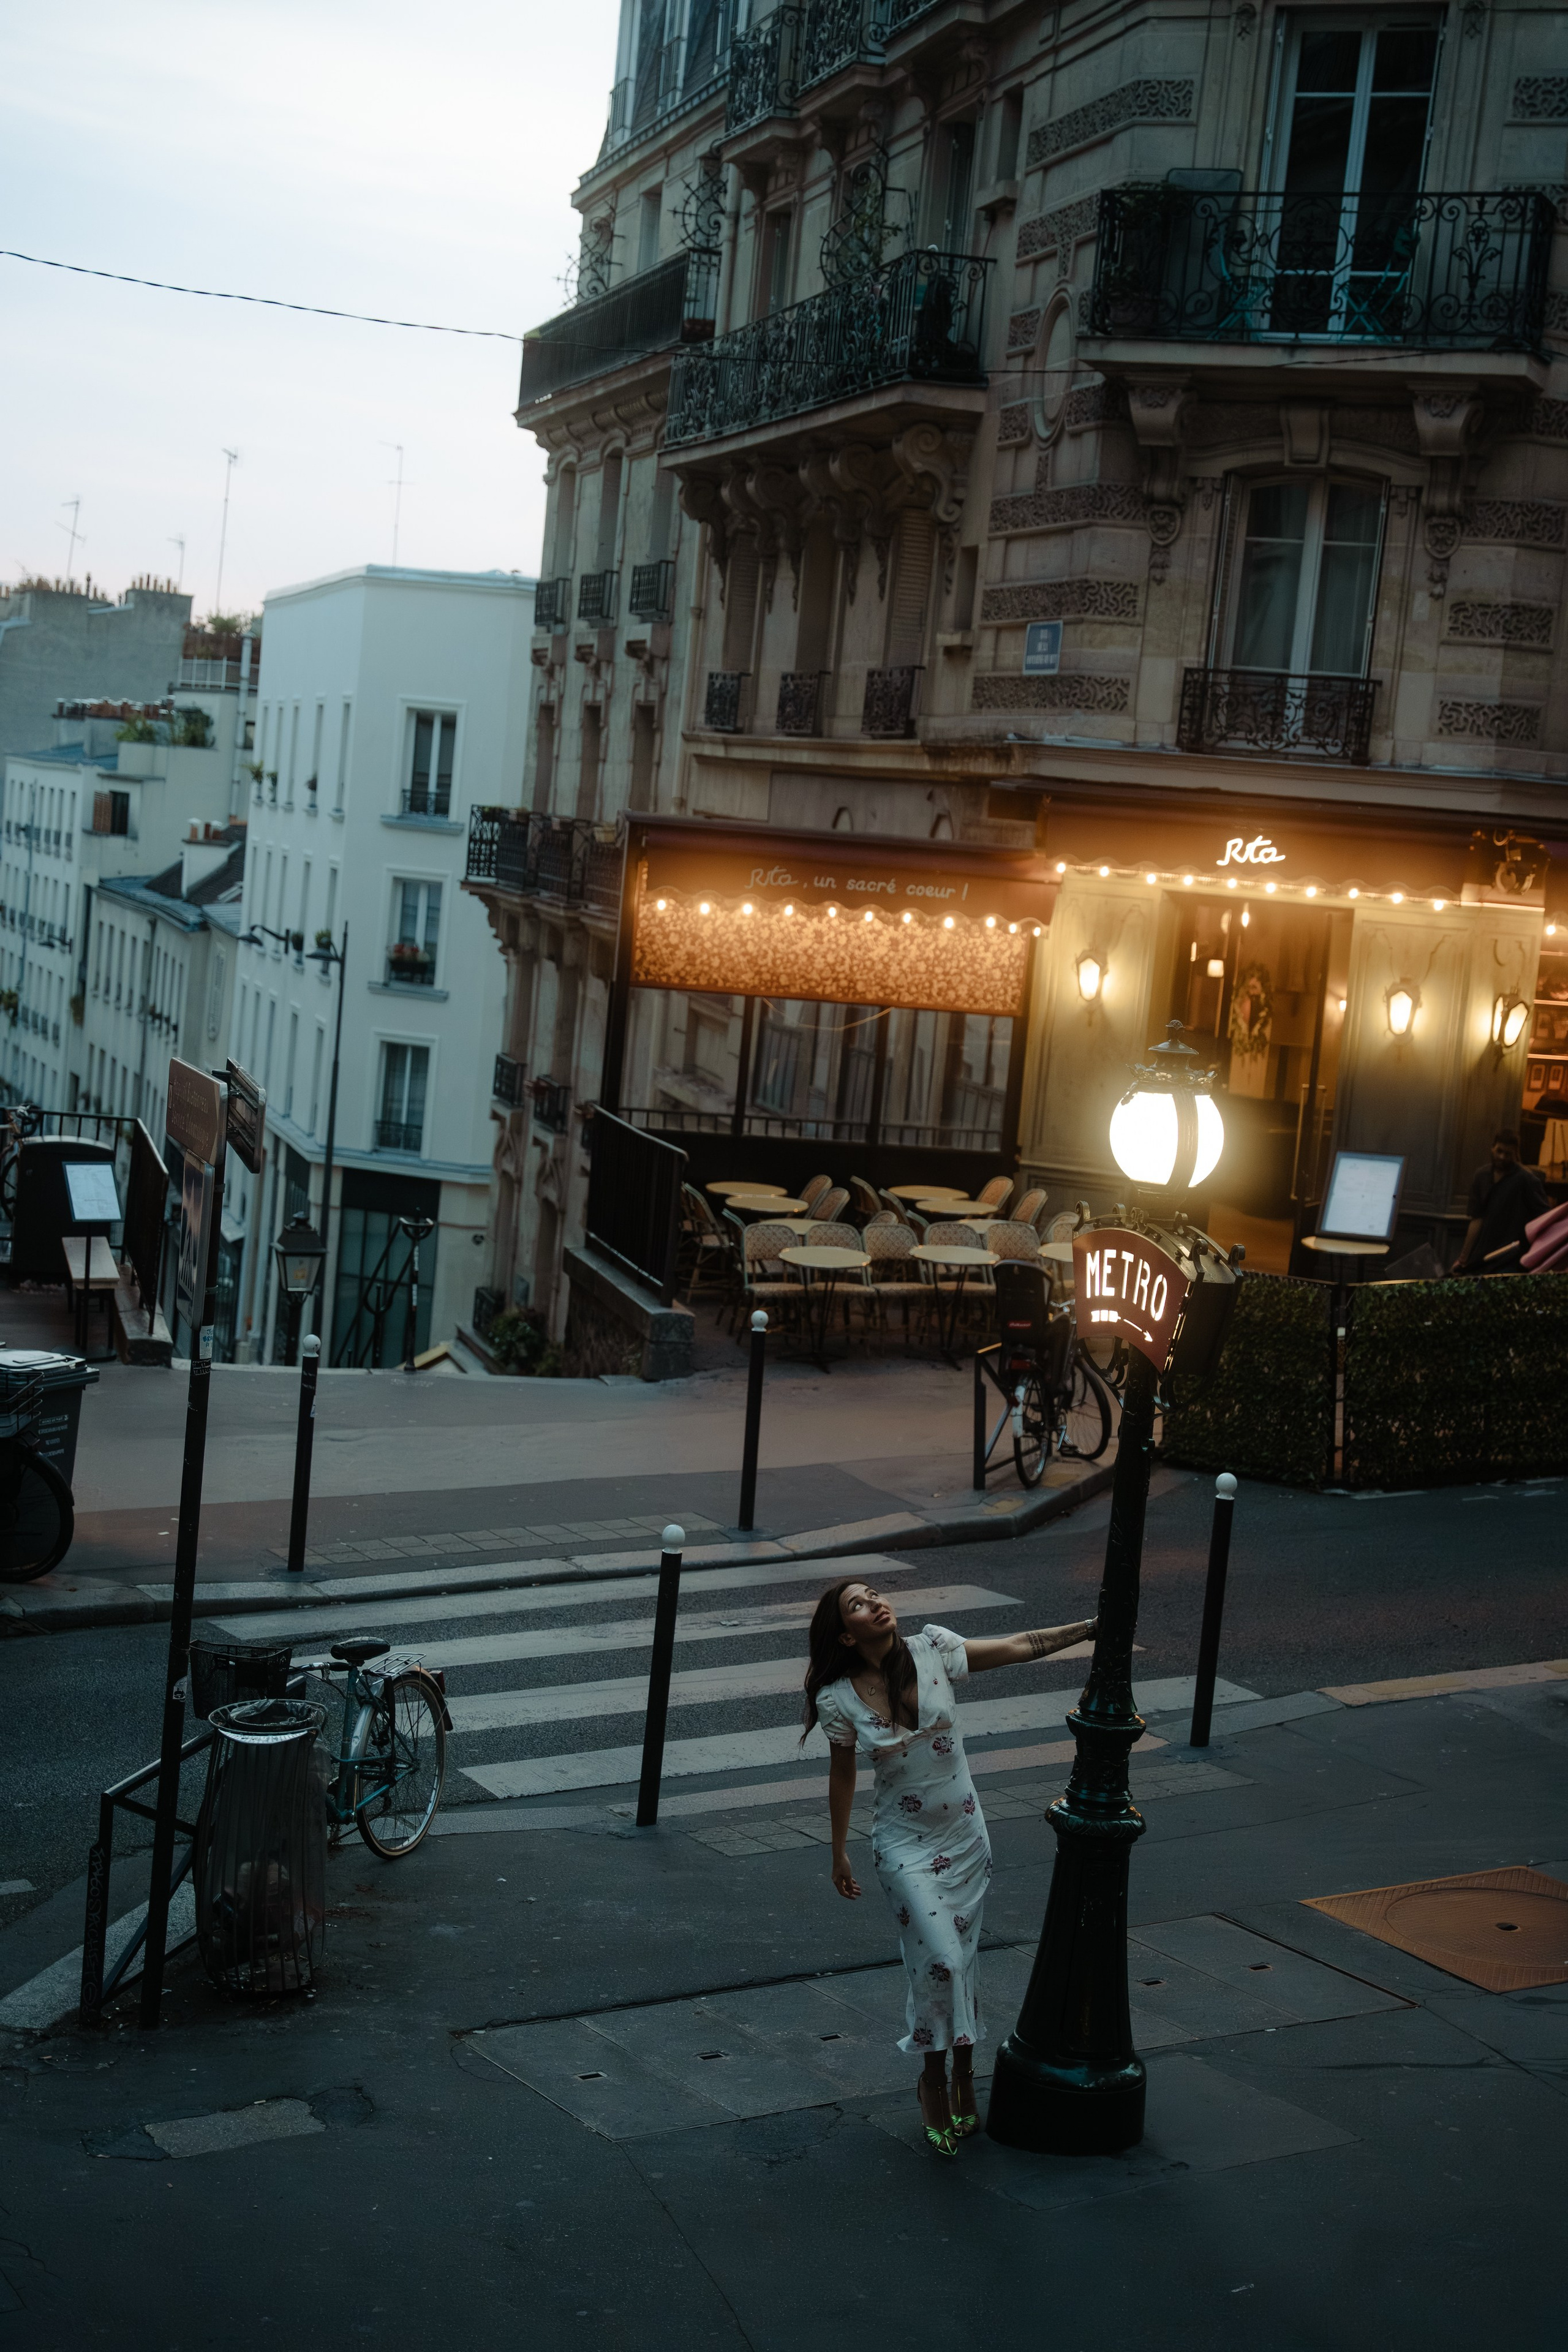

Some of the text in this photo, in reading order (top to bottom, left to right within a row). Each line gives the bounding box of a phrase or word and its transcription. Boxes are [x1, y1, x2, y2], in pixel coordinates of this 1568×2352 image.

[1216, 835, 1286, 865] Rita
[813, 876, 837, 889] un
[846, 878, 896, 894] sacré
[906, 884, 956, 899] coeur
[1087, 1249, 1168, 1321] METRO
